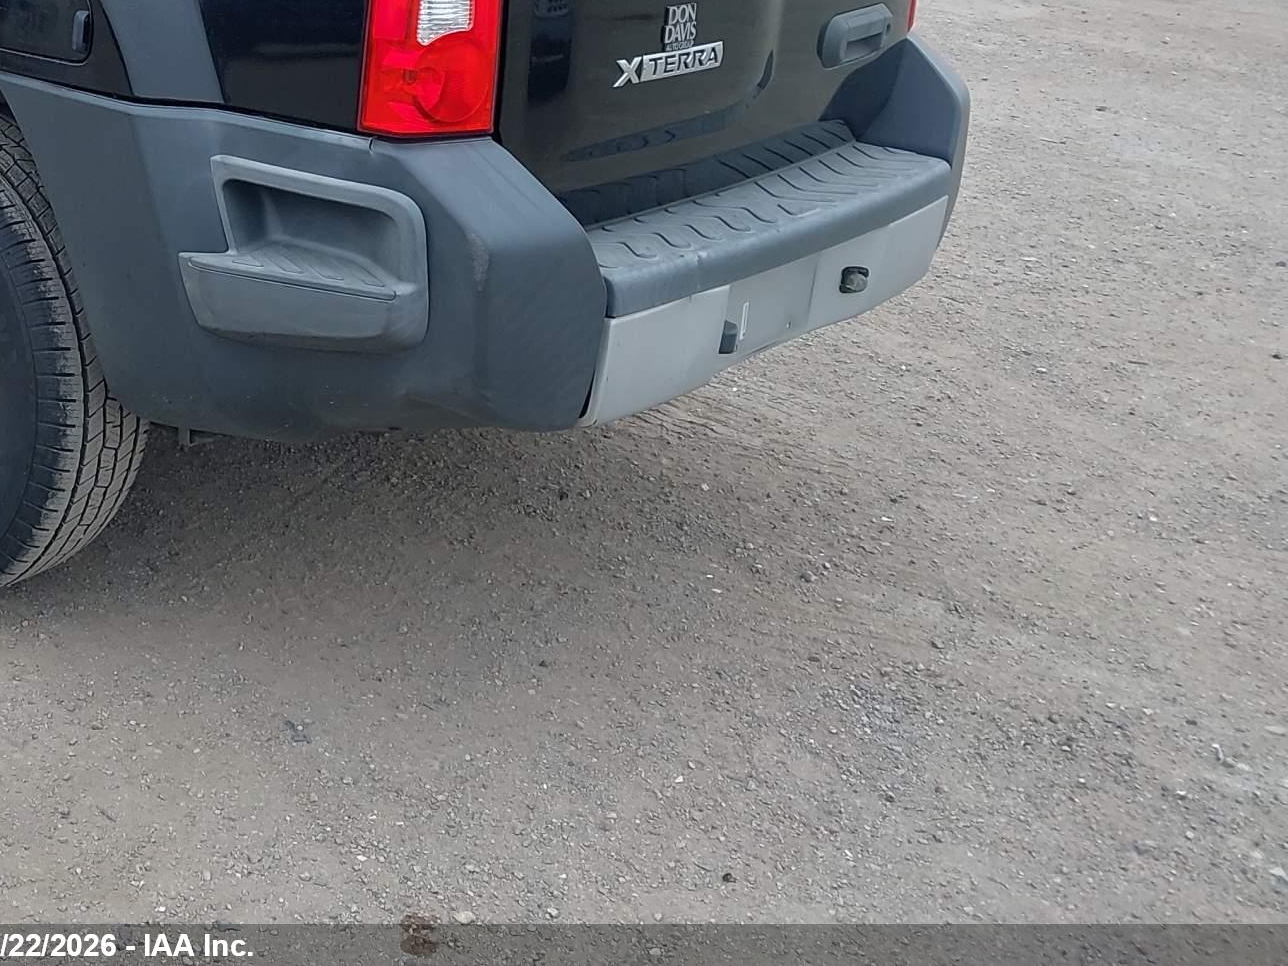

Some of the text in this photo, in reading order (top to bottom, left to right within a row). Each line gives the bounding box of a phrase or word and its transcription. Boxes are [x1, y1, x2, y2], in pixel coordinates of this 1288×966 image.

[667, 2, 697, 25] DON
[664, 21, 697, 44] DAVIS
[613, 42, 723, 87] XTERRA
